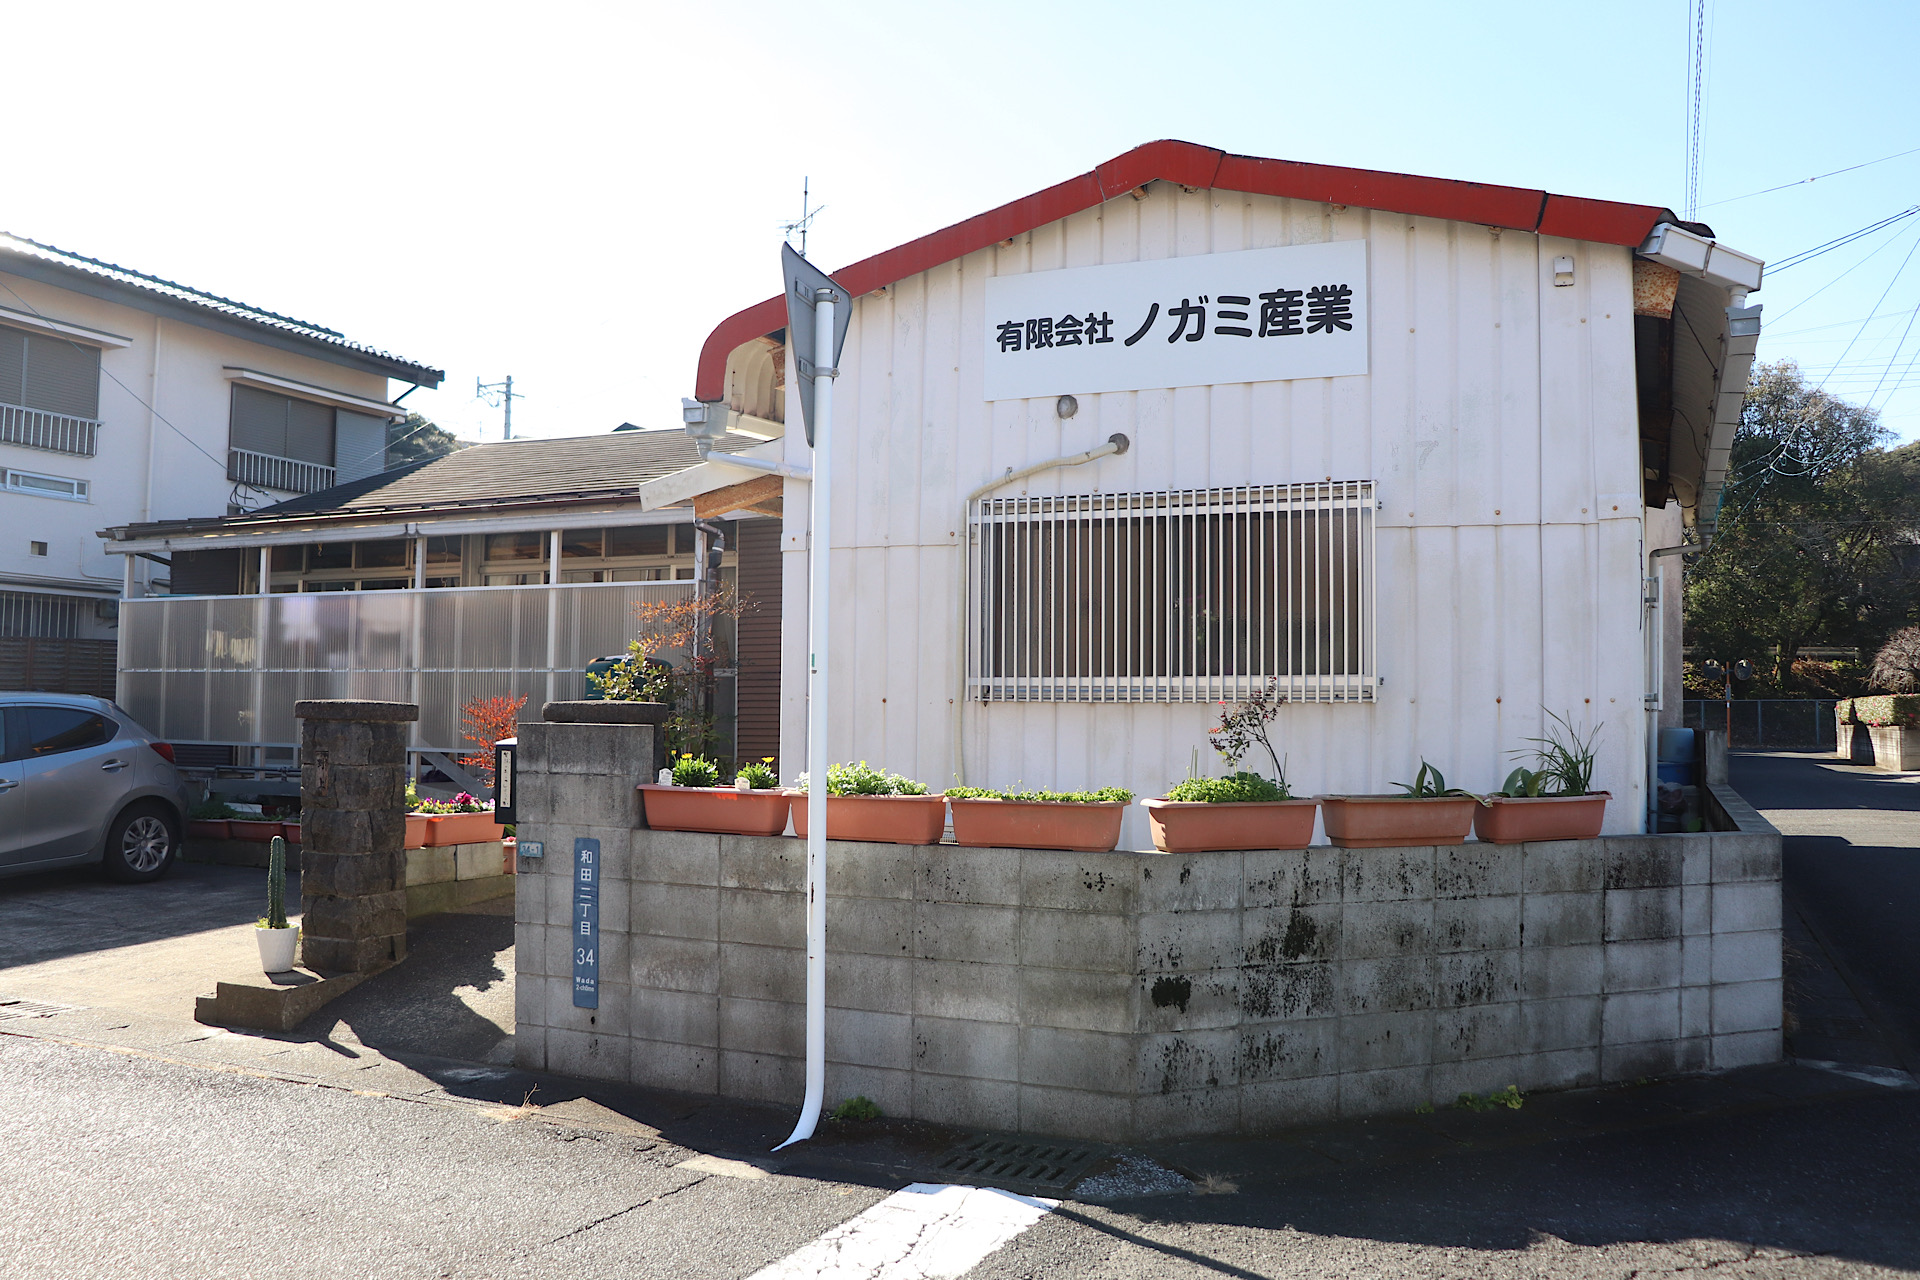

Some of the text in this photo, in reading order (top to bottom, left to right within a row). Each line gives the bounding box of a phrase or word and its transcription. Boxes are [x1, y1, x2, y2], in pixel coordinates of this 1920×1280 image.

[996, 283, 1353, 353] 有限会社 ノガミ産業
[580, 849, 593, 936] 和田二丁目
[576, 947, 595, 966] 34
[575, 976, 595, 985] Wada
